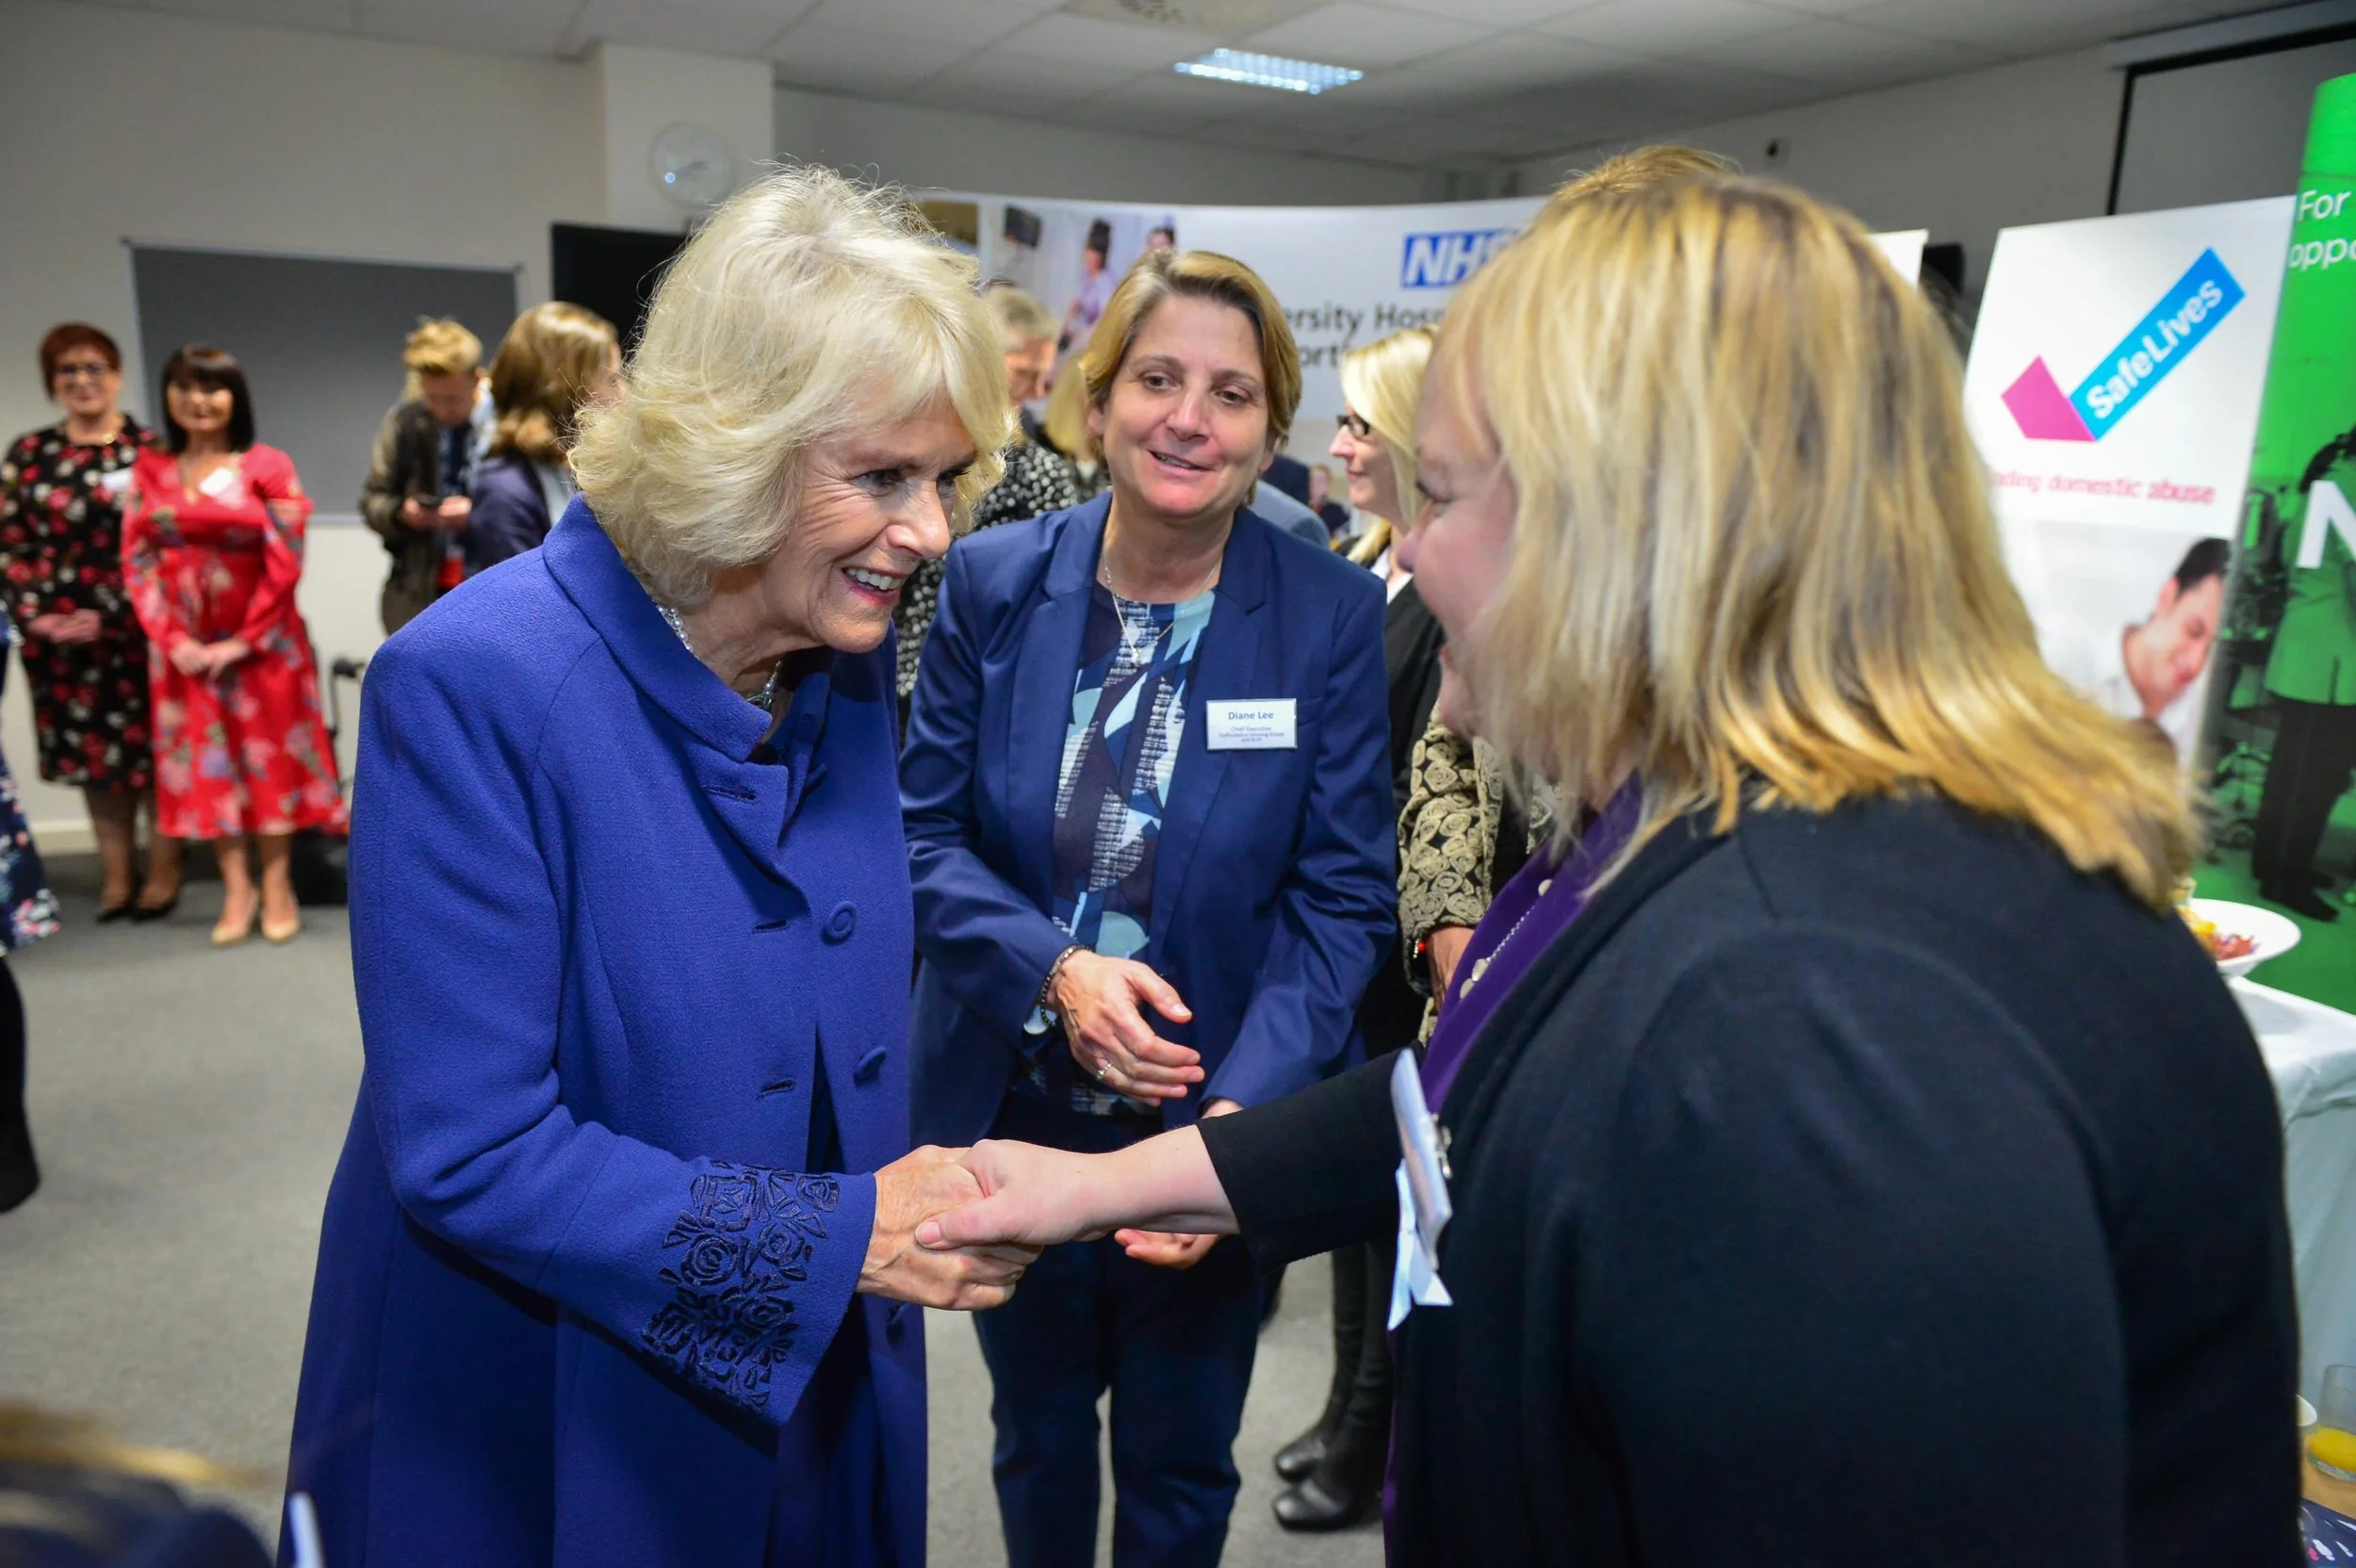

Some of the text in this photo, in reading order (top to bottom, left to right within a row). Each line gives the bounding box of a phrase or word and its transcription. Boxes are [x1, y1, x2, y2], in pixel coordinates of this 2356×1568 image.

[2298, 189, 2351, 220] For
[1284, 300, 1365, 351] ersity
[2086, 280, 2223, 419] SafeLives
[1228, 710, 1274, 720] Diane Lee
